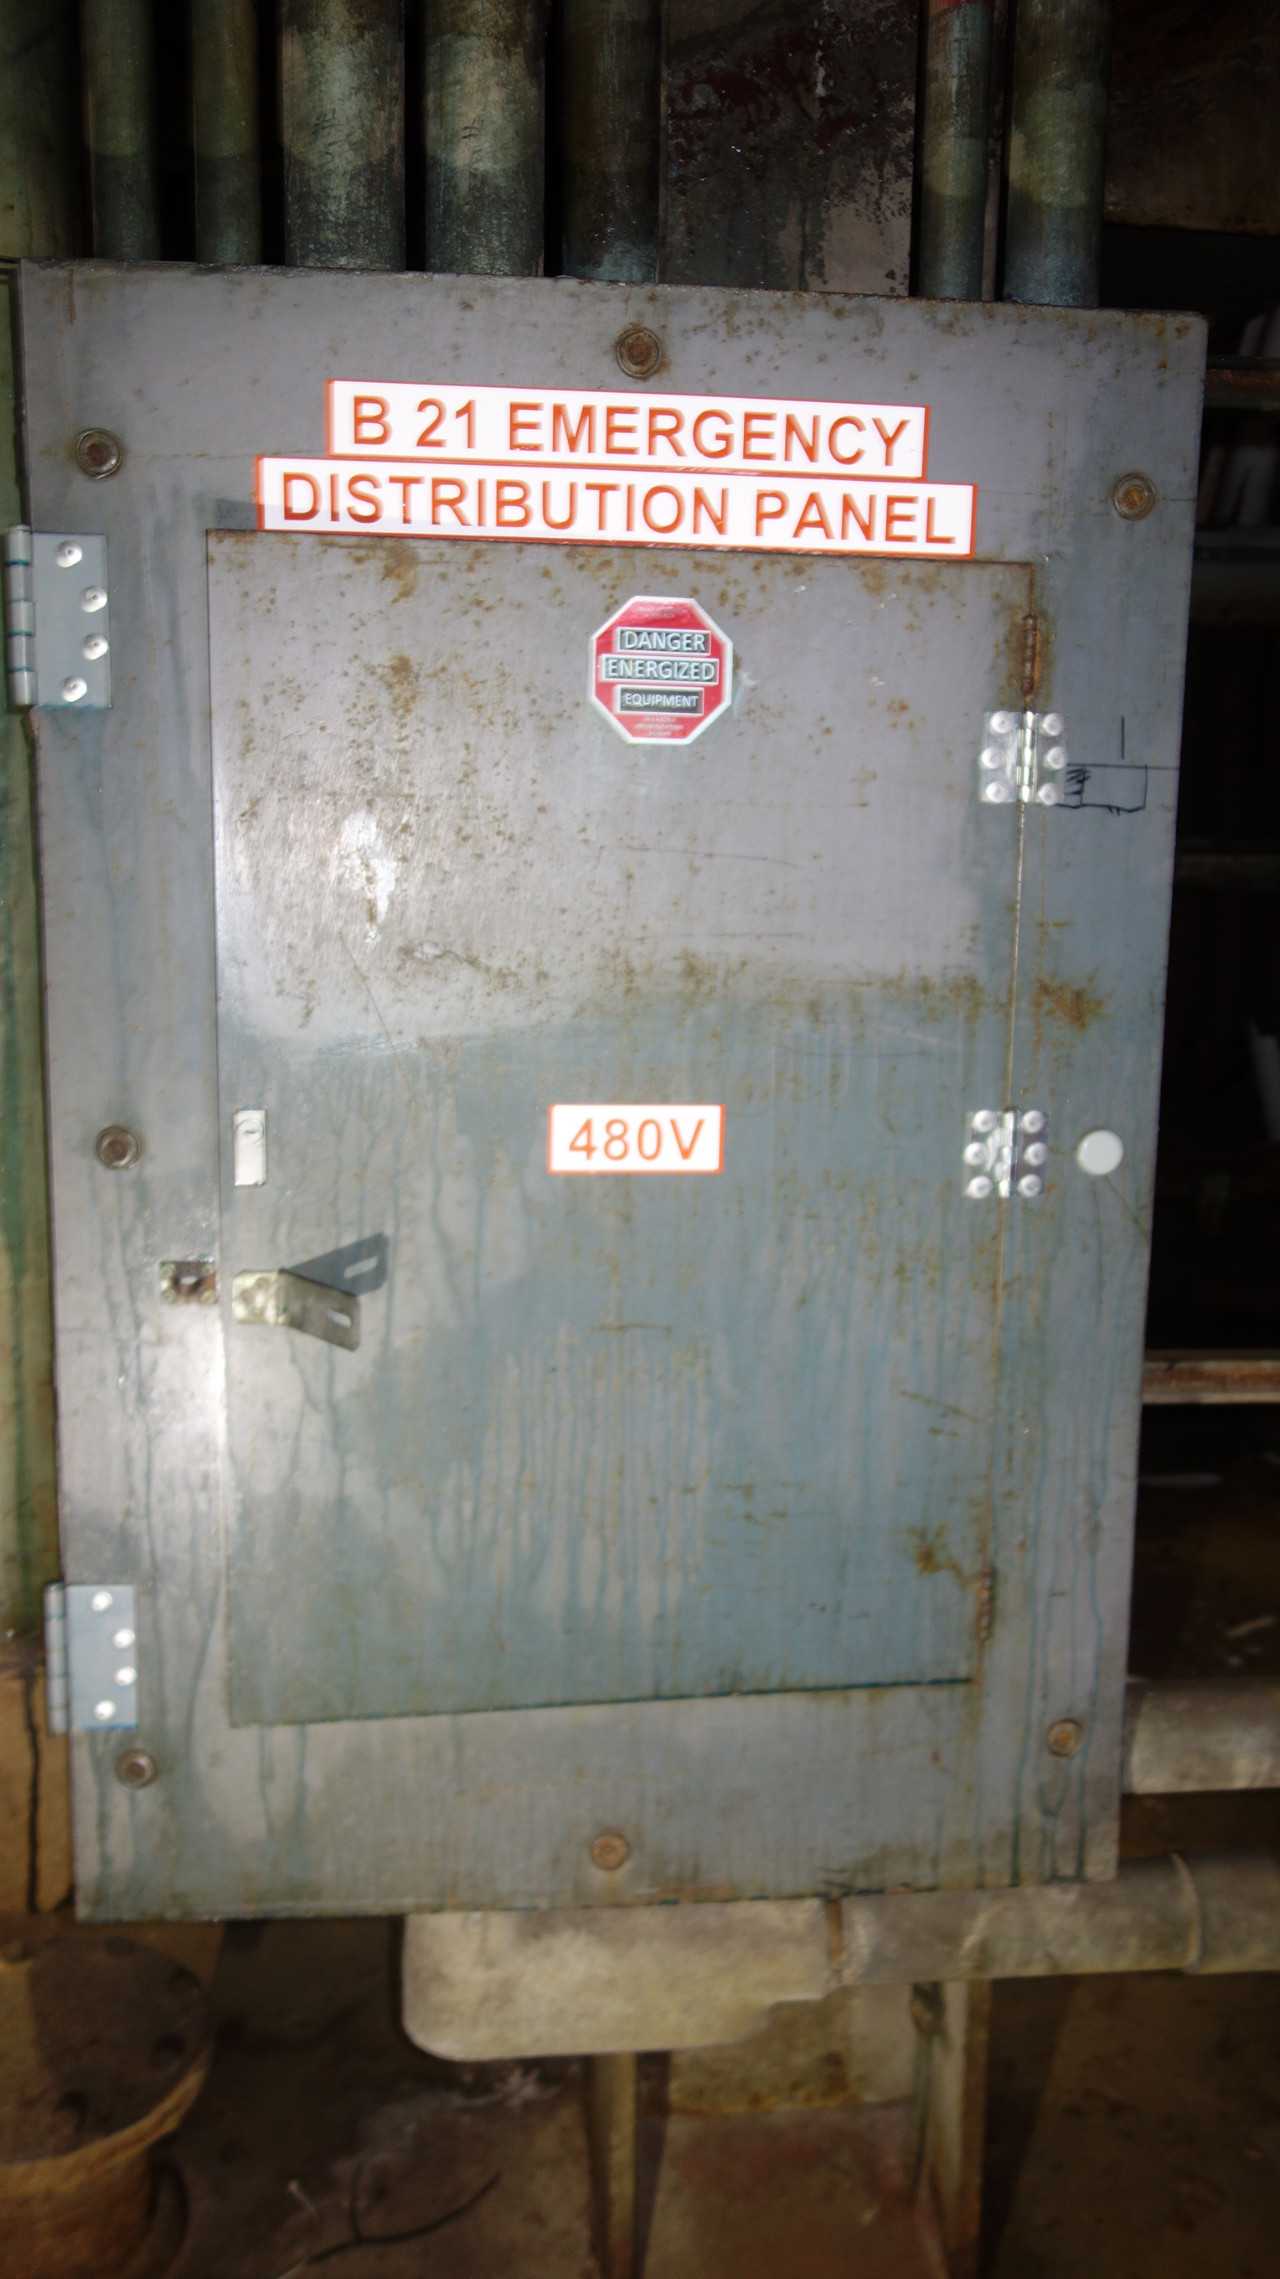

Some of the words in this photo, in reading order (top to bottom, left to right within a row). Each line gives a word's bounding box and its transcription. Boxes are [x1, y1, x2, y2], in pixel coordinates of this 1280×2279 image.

[353, 396, 391, 445] B
[416, 398, 477, 450] 21
[509, 402, 911, 466] EMERGENCY
[283, 473, 730, 536] DISTRIBUTION
[755, 489, 957, 545] PANEL
[624, 630, 706, 651] DANGER
[608, 659, 715, 681] ENERGIZED
[623, 693, 699, 708] EQUIPMENT
[569, 1118, 705, 1161] 480V
